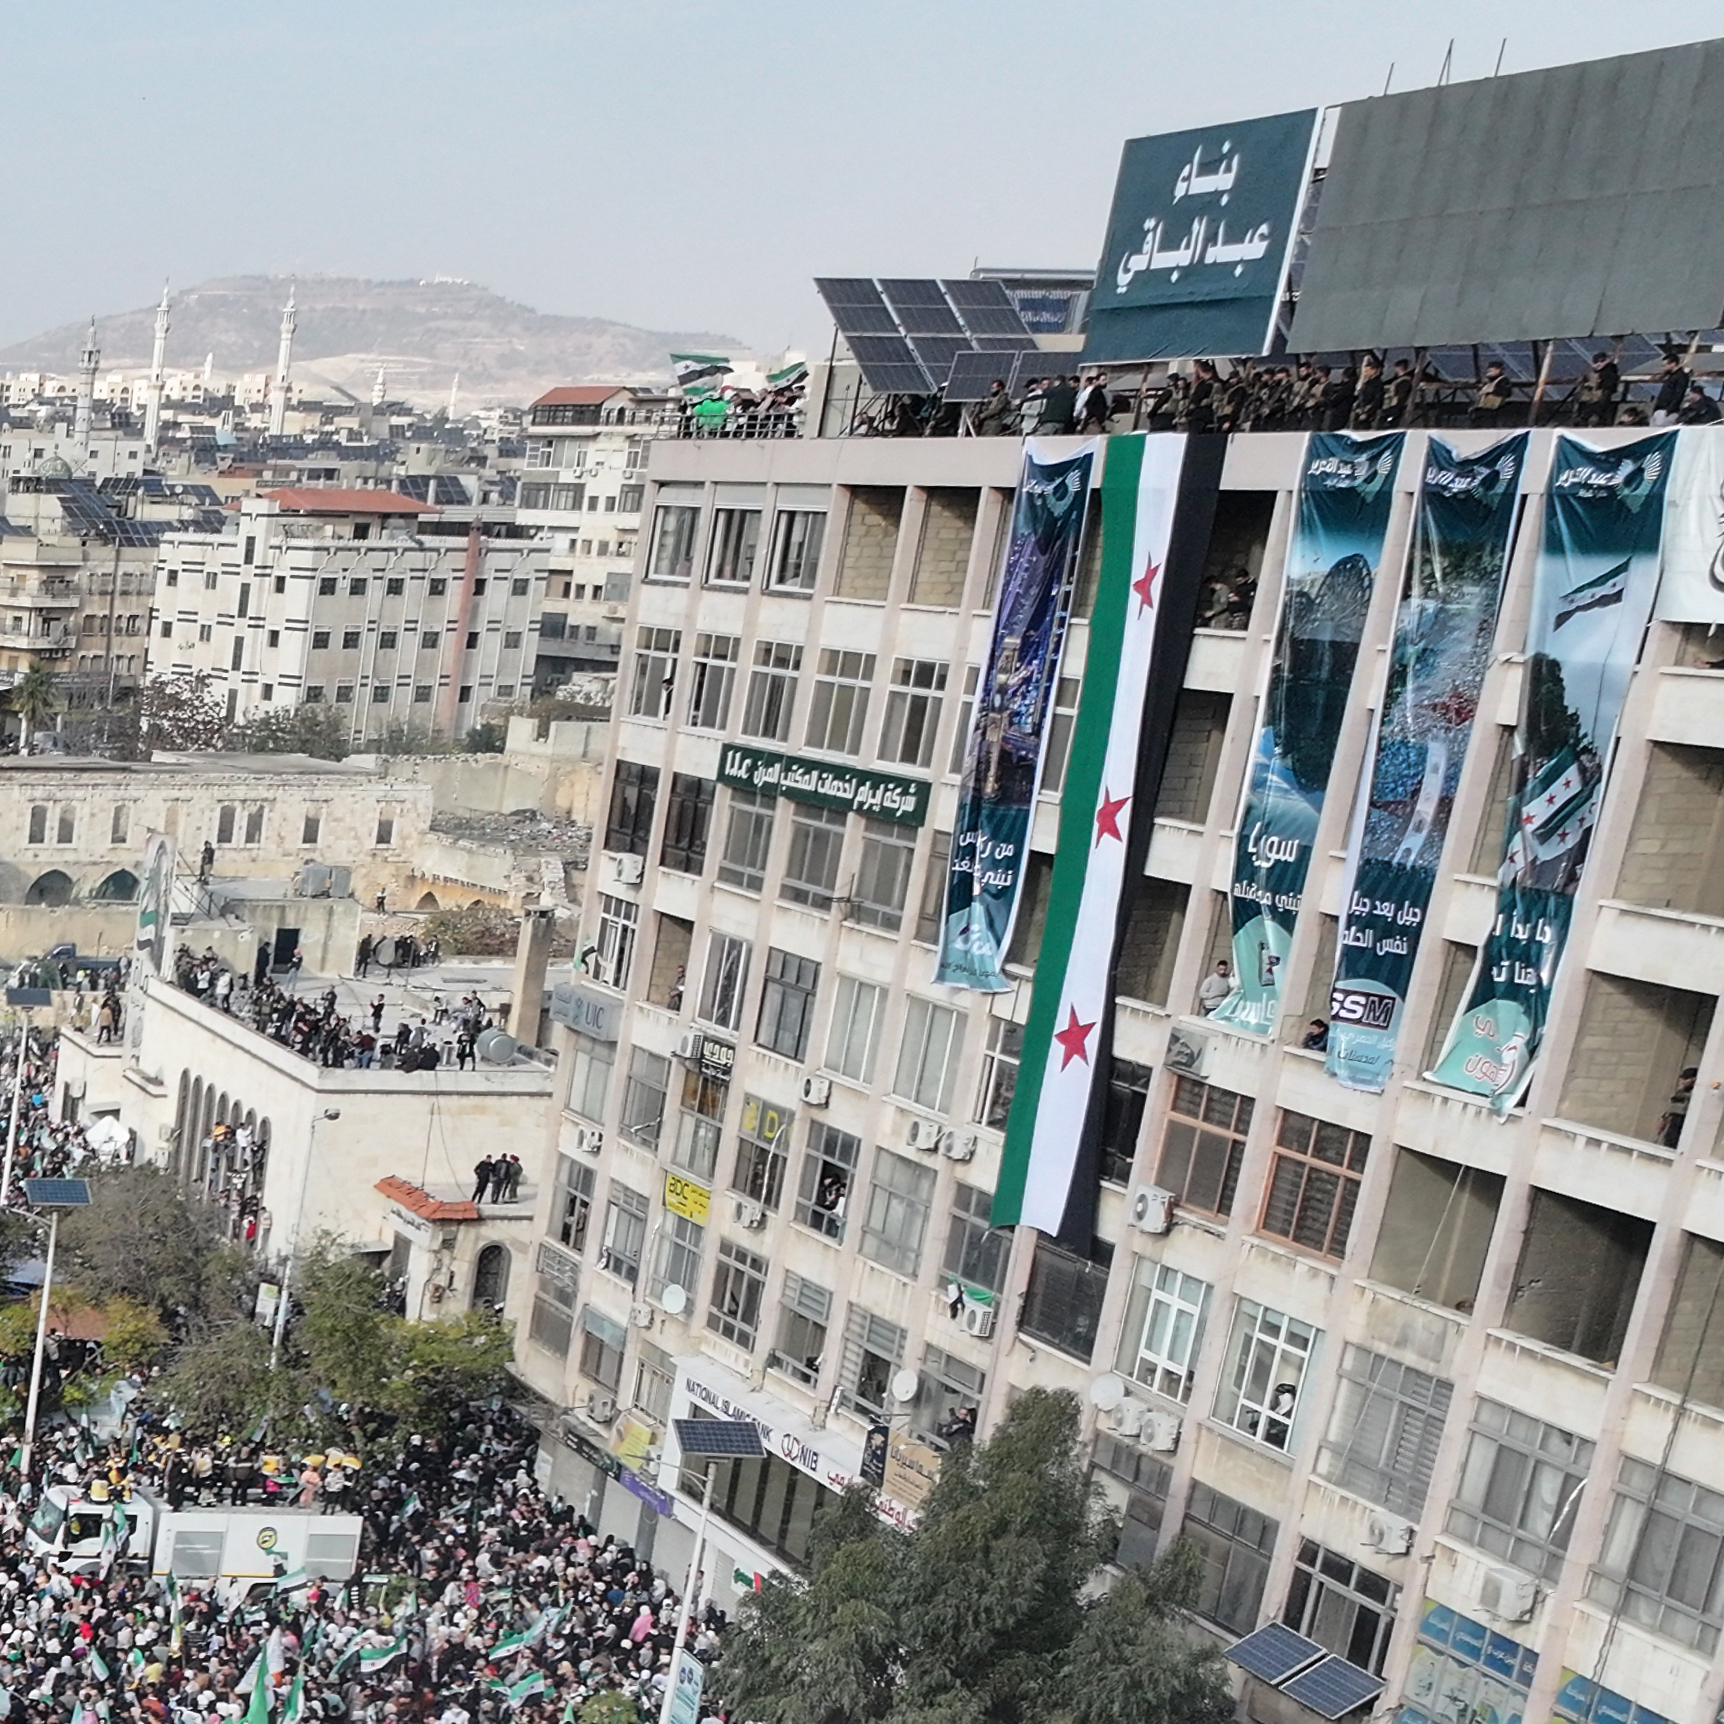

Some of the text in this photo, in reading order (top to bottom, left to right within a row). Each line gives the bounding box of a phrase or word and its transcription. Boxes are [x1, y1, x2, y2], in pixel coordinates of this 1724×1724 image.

[1172, 139, 1240, 206] بناء
[1115, 215, 1271, 294] عبد الباقي
[753, 761, 781, 787] المرن
[780, 764, 818, 791] المكتب
[817, 774, 857, 799] لخدمات
[883, 783, 917, 817] شركة
[995, 843, 1014, 859] من
[1248, 821, 1299, 868] سوريا
[1373, 900, 1395, 922] بعد
[1397, 900, 1421, 927] جيل
[1376, 935, 1408, 956] نفس
[585, 1002, 605, 1029] UIC
[685, 1377, 719, 1410] NATIONAL
[799, 1444, 819, 1472] NIB
